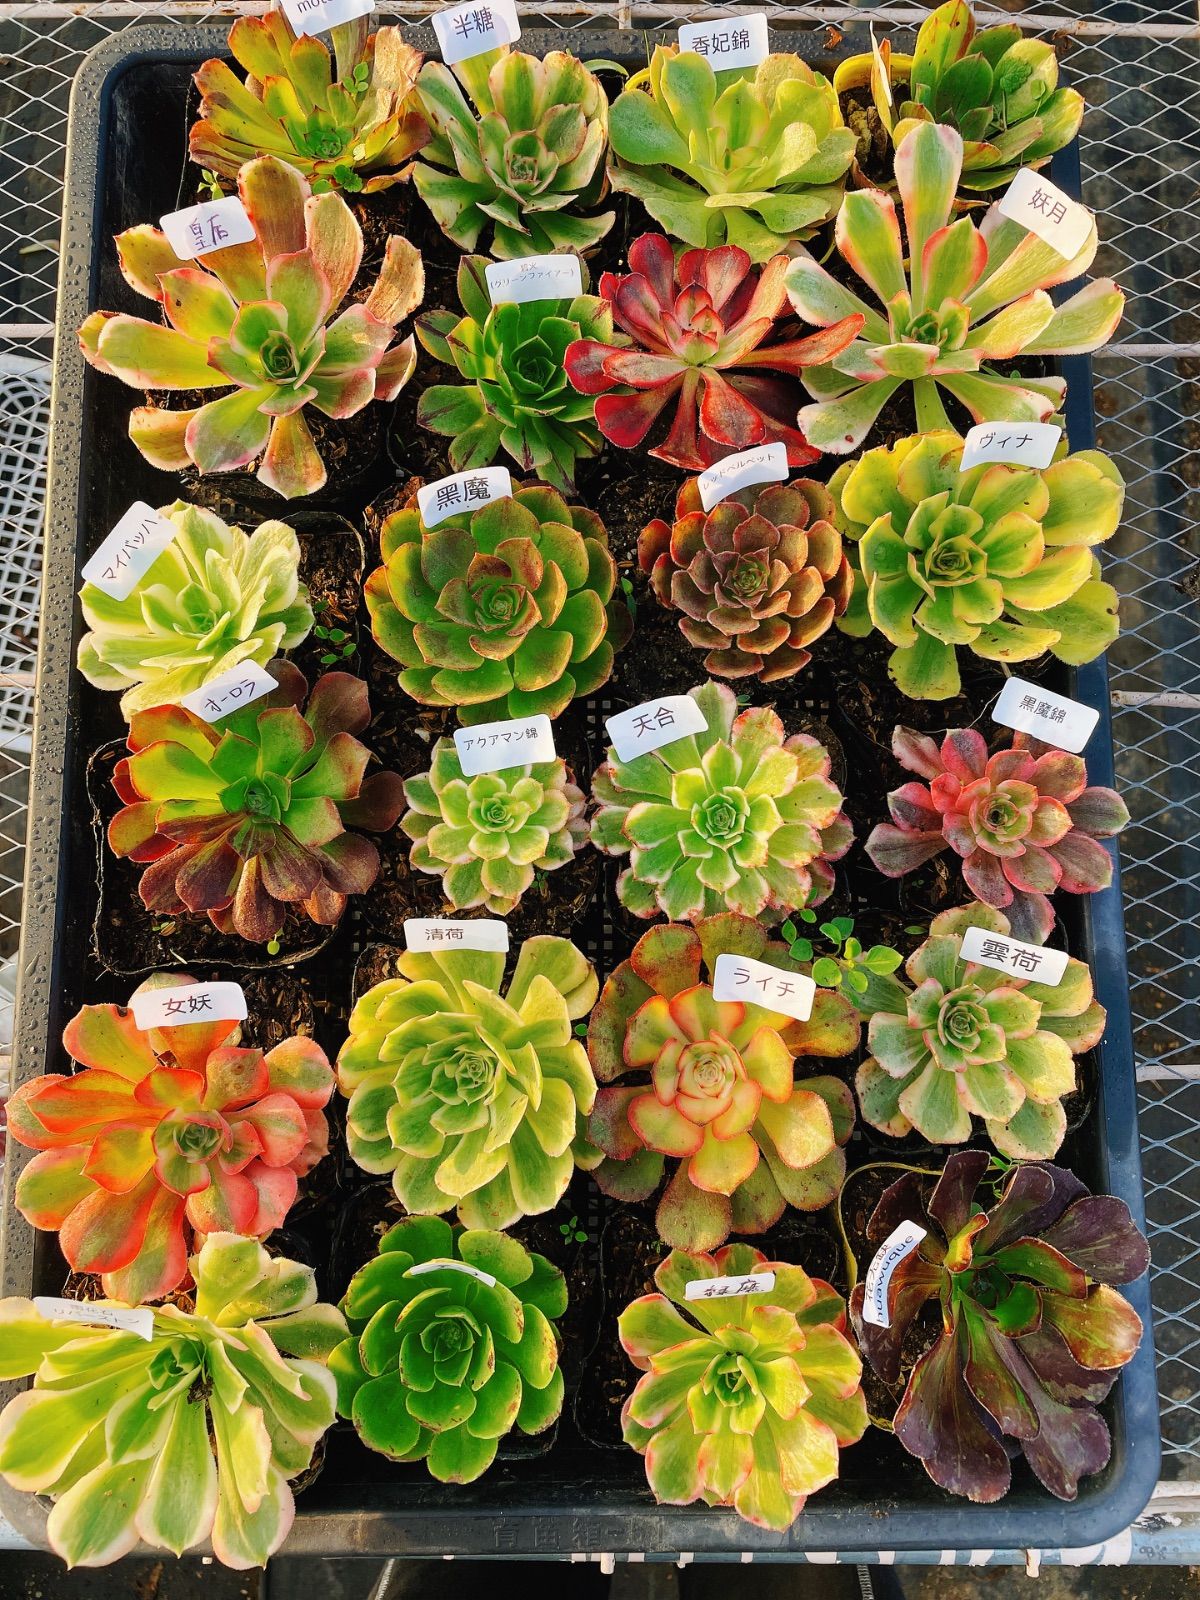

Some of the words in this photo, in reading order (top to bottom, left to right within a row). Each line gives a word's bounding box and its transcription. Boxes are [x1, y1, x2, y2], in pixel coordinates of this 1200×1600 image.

[454, 11, 496, 39] 半糖
[690, 29, 750, 55] 香妃錦
[1027, 187, 1069, 224] 妖月
[189, 214, 230, 251] 皇后
[980, 433, 1034, 449] ヴィナ
[101, 517, 159, 581] マイバッハ
[204, 678, 257, 712] オーロラ
[631, 706, 675, 737] 天合
[462, 727, 538, 751] アクアマン錦
[425, 928, 464, 941] 清荷
[980, 938, 1043, 974] 雲荷
[733, 966, 797, 997] ライチ
[162, 993, 213, 1016] 女妖
[875, 1234, 915, 1324] huawuque
